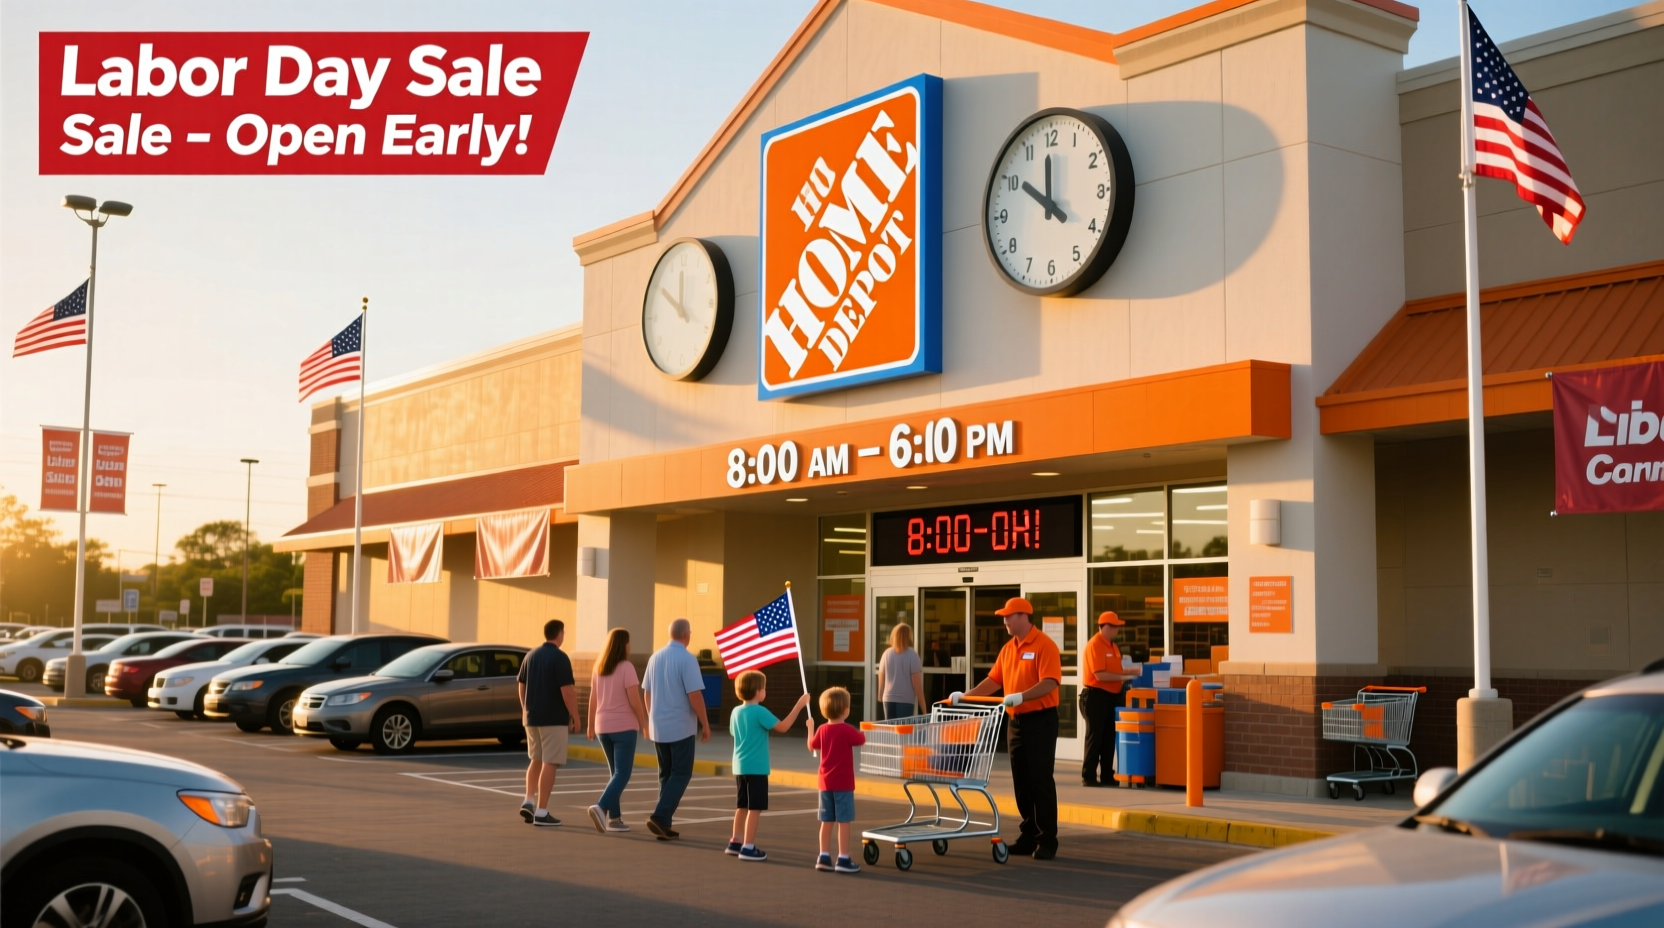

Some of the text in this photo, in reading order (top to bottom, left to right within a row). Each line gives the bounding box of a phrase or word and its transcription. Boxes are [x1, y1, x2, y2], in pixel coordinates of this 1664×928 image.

[1045, 129, 1058, 148] 12
[1072, 132, 1076, 148] 1
[1025, 144, 1034, 161] 11
[1088, 152, 1098, 169] 2
[1007, 174, 1019, 192] 10
[1096, 184, 1105, 199] 3
[790, 155, 837, 232] HO
[999, 208, 1008, 224] 9
[1088, 217, 1097, 233] 4
[764, 109, 919, 379] HOME
[1009, 237, 1017, 254] 8
[1072, 245, 1081, 262] 5
[1026, 257, 1033, 273] 7
[1047, 259, 1056, 276] 6
[817, 208, 913, 372] DEPOT
[726, 440, 799, 489] 8:00
[807, 443, 850, 478] AM
[889, 417, 958, 469] 6:10
[966, 420, 1014, 459] PM
